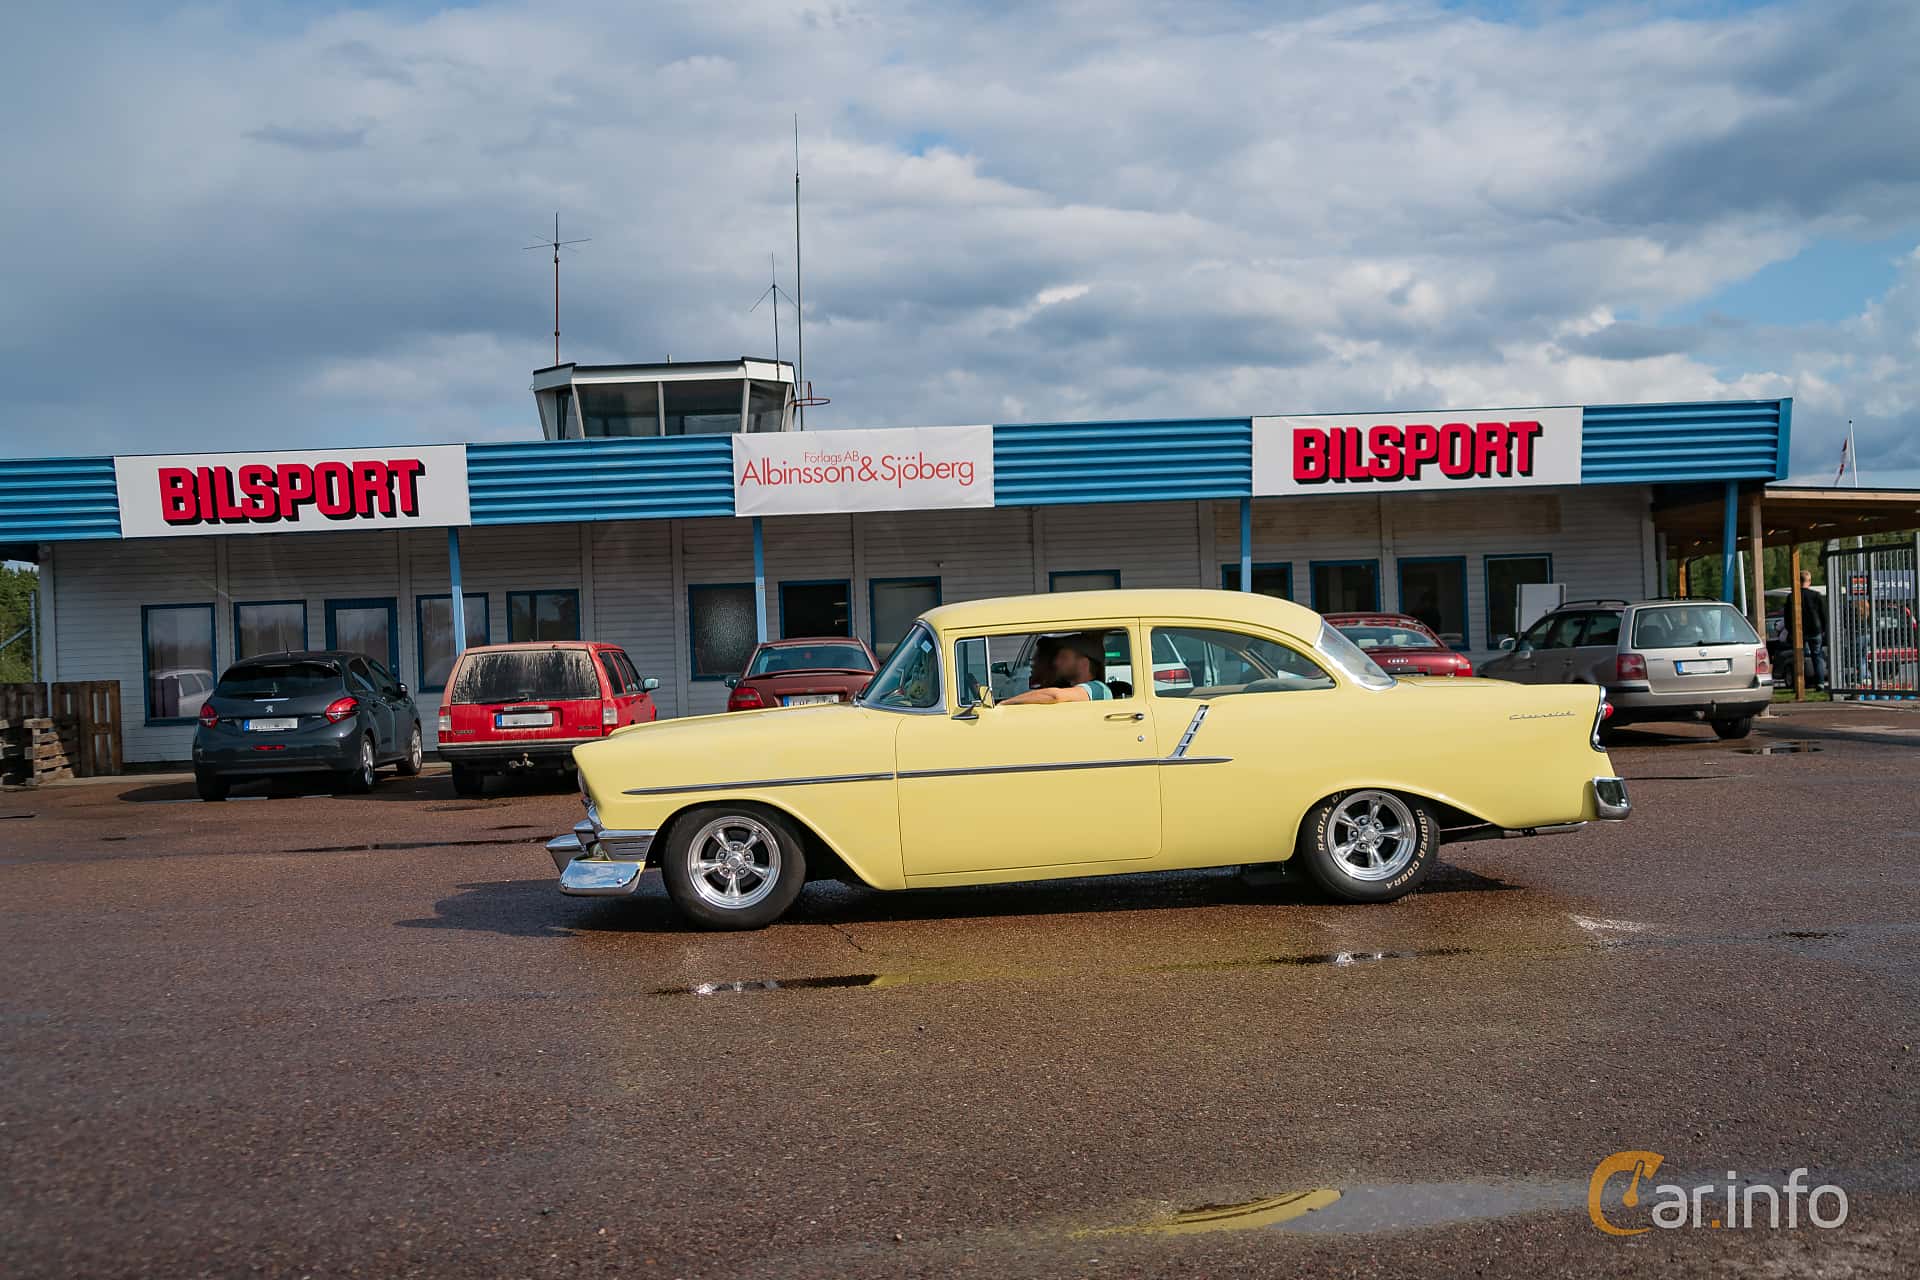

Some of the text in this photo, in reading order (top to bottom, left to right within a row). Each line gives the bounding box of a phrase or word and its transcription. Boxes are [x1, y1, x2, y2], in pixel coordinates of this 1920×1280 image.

[843, 450, 860, 463] AB
[880, 451, 975, 489] Sjöberg
[1293, 421, 1543, 484] BILSPORT
[158, 459, 426, 525] BILSPORT
[1316, 805, 1332, 851] RADIAL
[1386, 808, 1430, 889] COOPER COBRA
